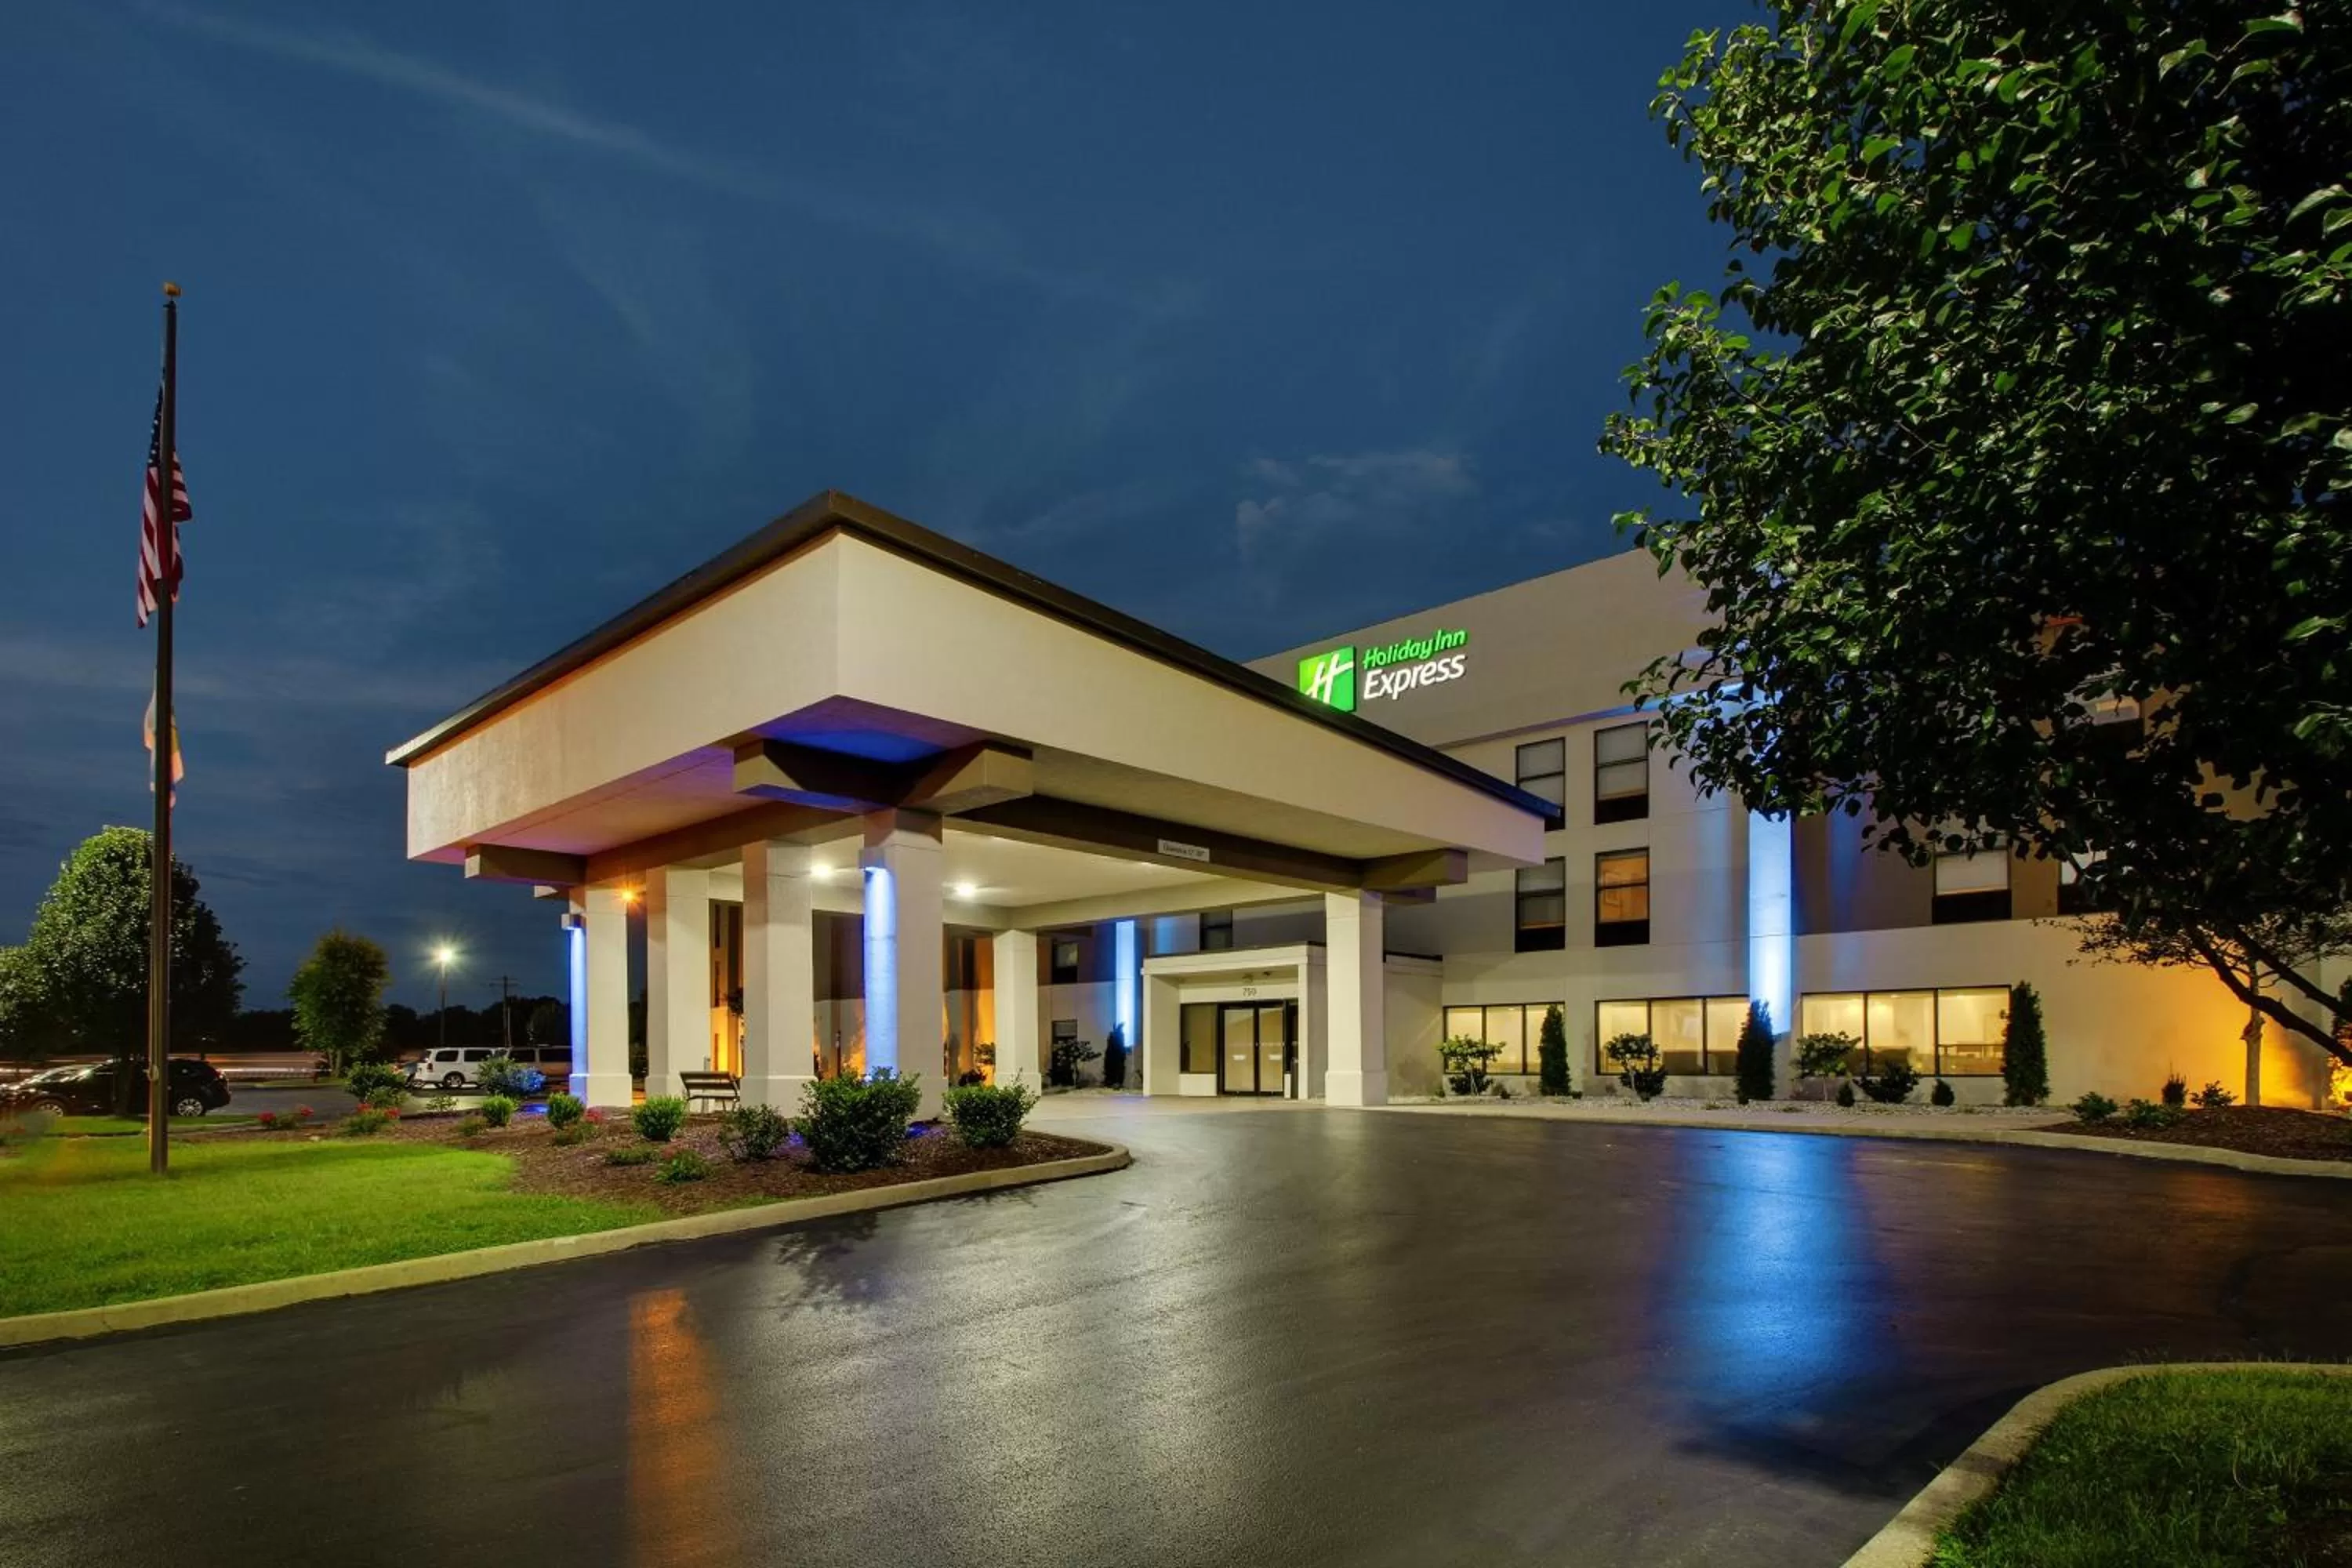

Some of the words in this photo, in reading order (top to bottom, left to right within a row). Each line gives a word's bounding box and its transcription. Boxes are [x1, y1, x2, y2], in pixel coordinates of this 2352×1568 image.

[1363, 637, 1432, 669] Holiday
[1434, 629, 1466, 652] Inn
[1363, 654, 1467, 700] Express
